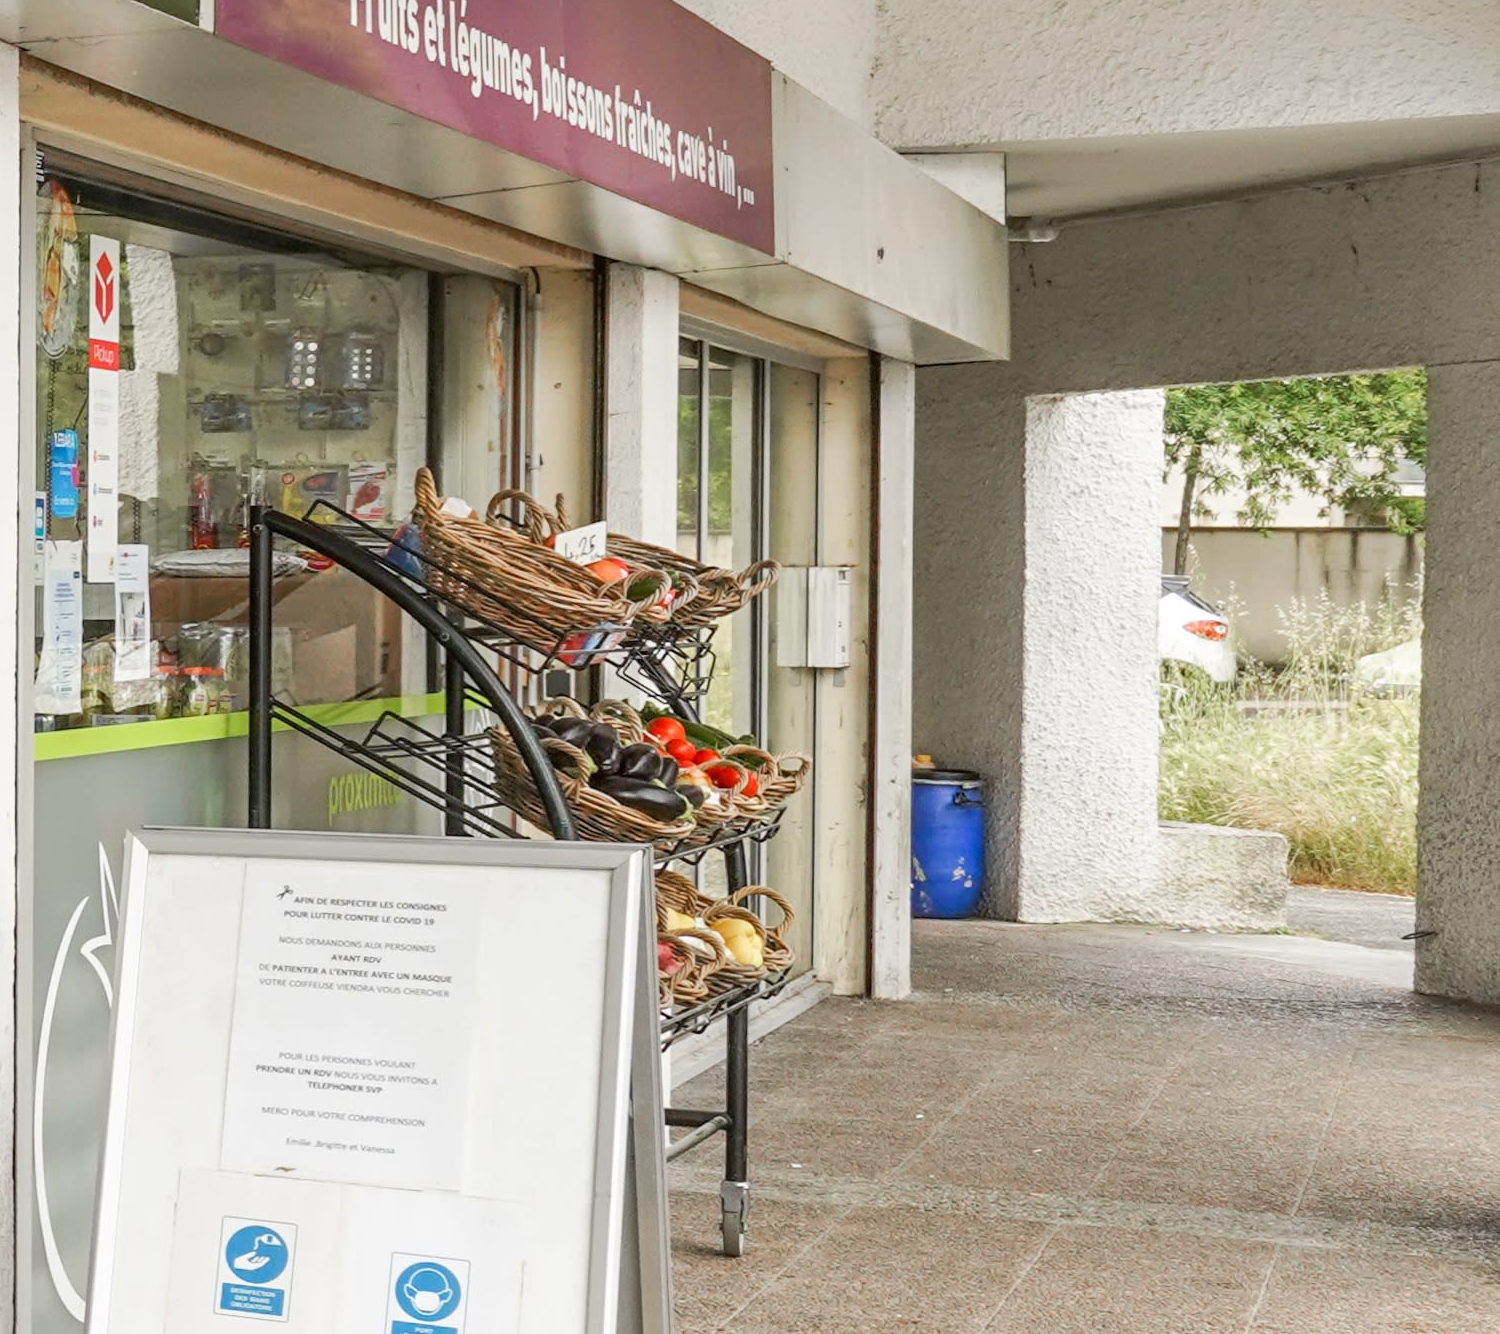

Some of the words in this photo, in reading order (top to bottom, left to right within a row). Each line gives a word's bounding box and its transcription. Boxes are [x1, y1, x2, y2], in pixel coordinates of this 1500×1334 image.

[450, 0, 539, 121] légumes,
[540, 46, 613, 142] boissons
[615, 85, 676, 182] fraîches,
[677, 130, 706, 184] cave
[708, 126, 716, 188] à
[717, 139, 735, 197] vin
[329, 898, 377, 908] RESPECTER
[395, 903, 446, 911] CONSIGNES
[283, 910, 308, 918] POUR
[310, 912, 342, 920] LUTTER
[344, 914, 379, 922] CONTRE
[392, 916, 421, 925] COVID
[278, 936, 303, 945] NOUS
[304, 938, 362, 948] DEMANDONS
[384, 943, 436, 952] PERSONNES
[330, 954, 360, 962] AYANT
[271, 965, 318, 974] PATIENTER
[370, 971, 394, 979] AVEC
[411, 974, 451, 983] MASQUE
[258, 978, 286, 986] VOTRE
[288, 980, 334, 989] COIFFEUSE
[335, 983, 374, 992] VIENDRA
[376, 986, 401, 994] VOUS
[402, 988, 449, 998] CHERCHER
